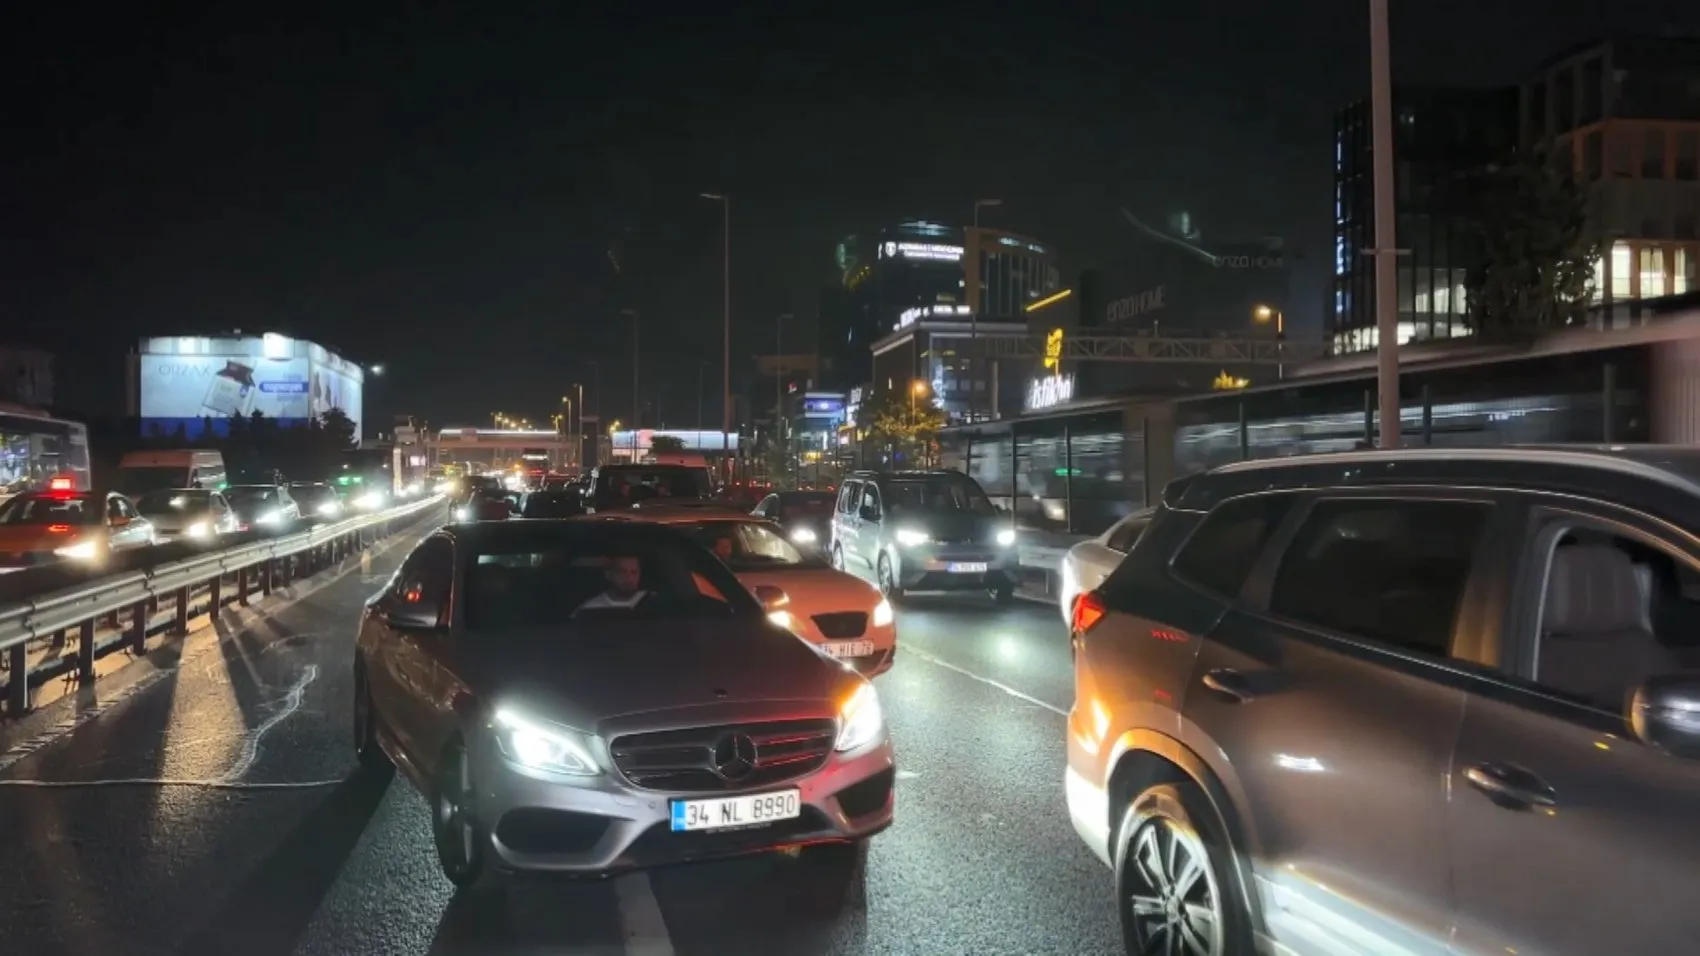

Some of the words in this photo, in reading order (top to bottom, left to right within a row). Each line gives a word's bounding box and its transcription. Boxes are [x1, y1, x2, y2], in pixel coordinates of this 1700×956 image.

[686, 804, 709, 826] 34
[721, 801, 742, 823] NL
[753, 794, 796, 819] 8990
